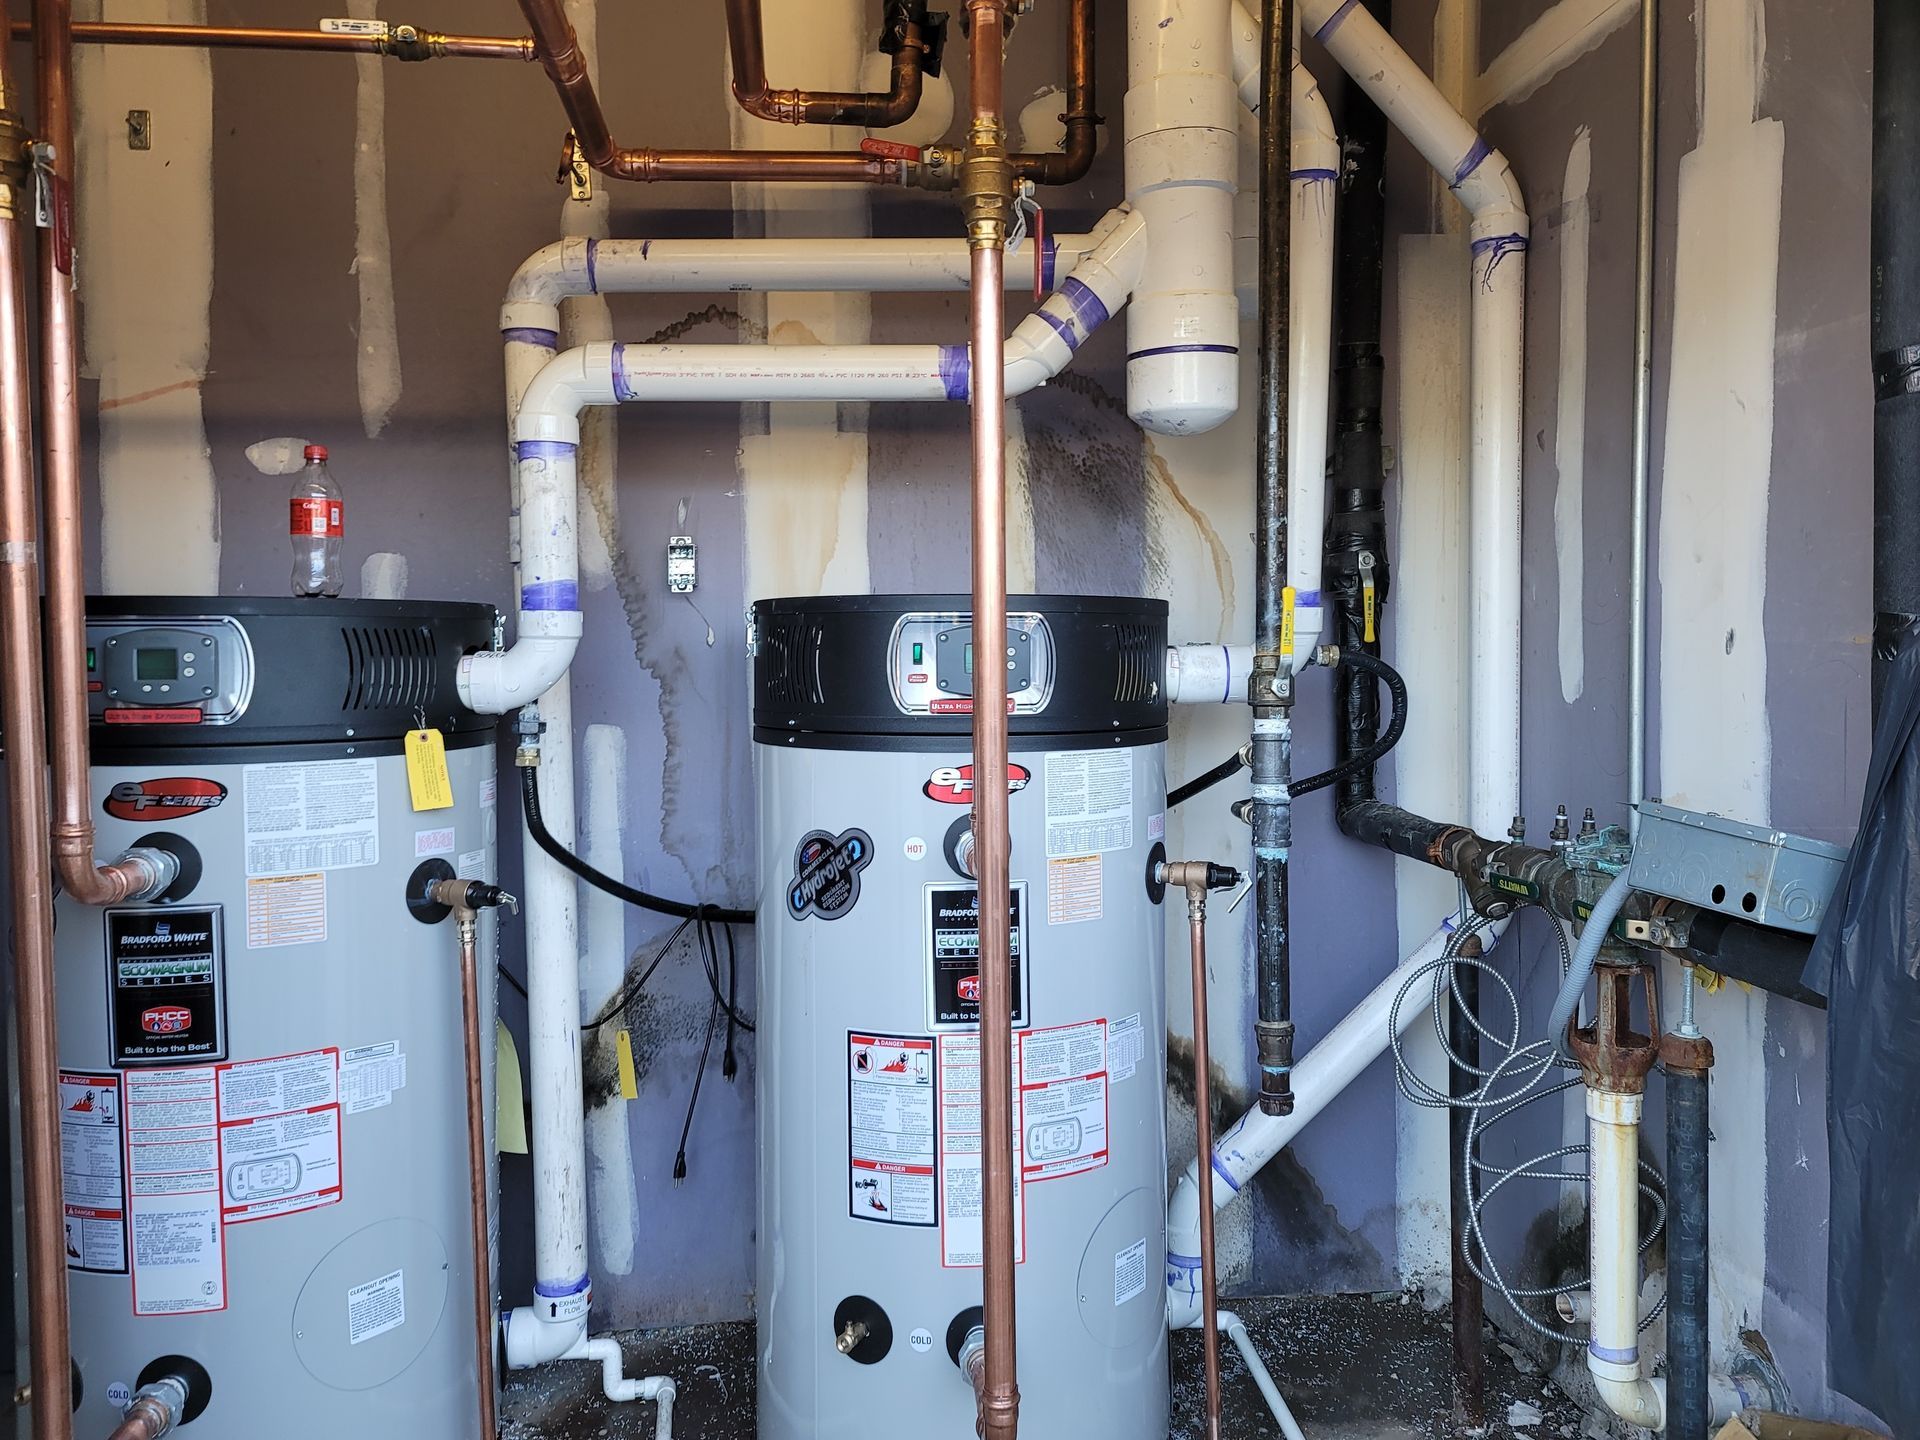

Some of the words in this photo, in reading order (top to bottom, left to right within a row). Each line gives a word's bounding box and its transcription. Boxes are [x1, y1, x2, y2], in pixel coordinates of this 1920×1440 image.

[161, 794, 222, 807] SERIES
[907, 845, 923, 853] HOT
[801, 846, 834, 878] COMMERCIAL
[800, 845, 851, 902] Hydrojet
[821, 879, 846, 903] SEDIMENT
[1498, 879, 1527, 895] WATTS
[939, 909, 979, 917] BRADFOR
[121, 934, 172, 945] BRADFORD
[174, 932, 208, 942] WHITE
[121, 974, 211, 986] SERIES
[144, 1010, 189, 1021] PHCC
[941, 1012, 958, 1020] Built
[125, 1046, 143, 1054] Built
[145, 1045, 155, 1053] to
[156, 1045, 169, 1053] be
[170, 1044, 186, 1052] the
[188, 1043, 211, 1051] Best
[350, 1281, 377, 1296] CLEANOUT
[559, 1295, 585, 1307] EXHAUST
[564, 1306, 581, 1315] FLOW
[911, 1336, 932, 1344] COLD
[108, 1390, 129, 1400] COLD
